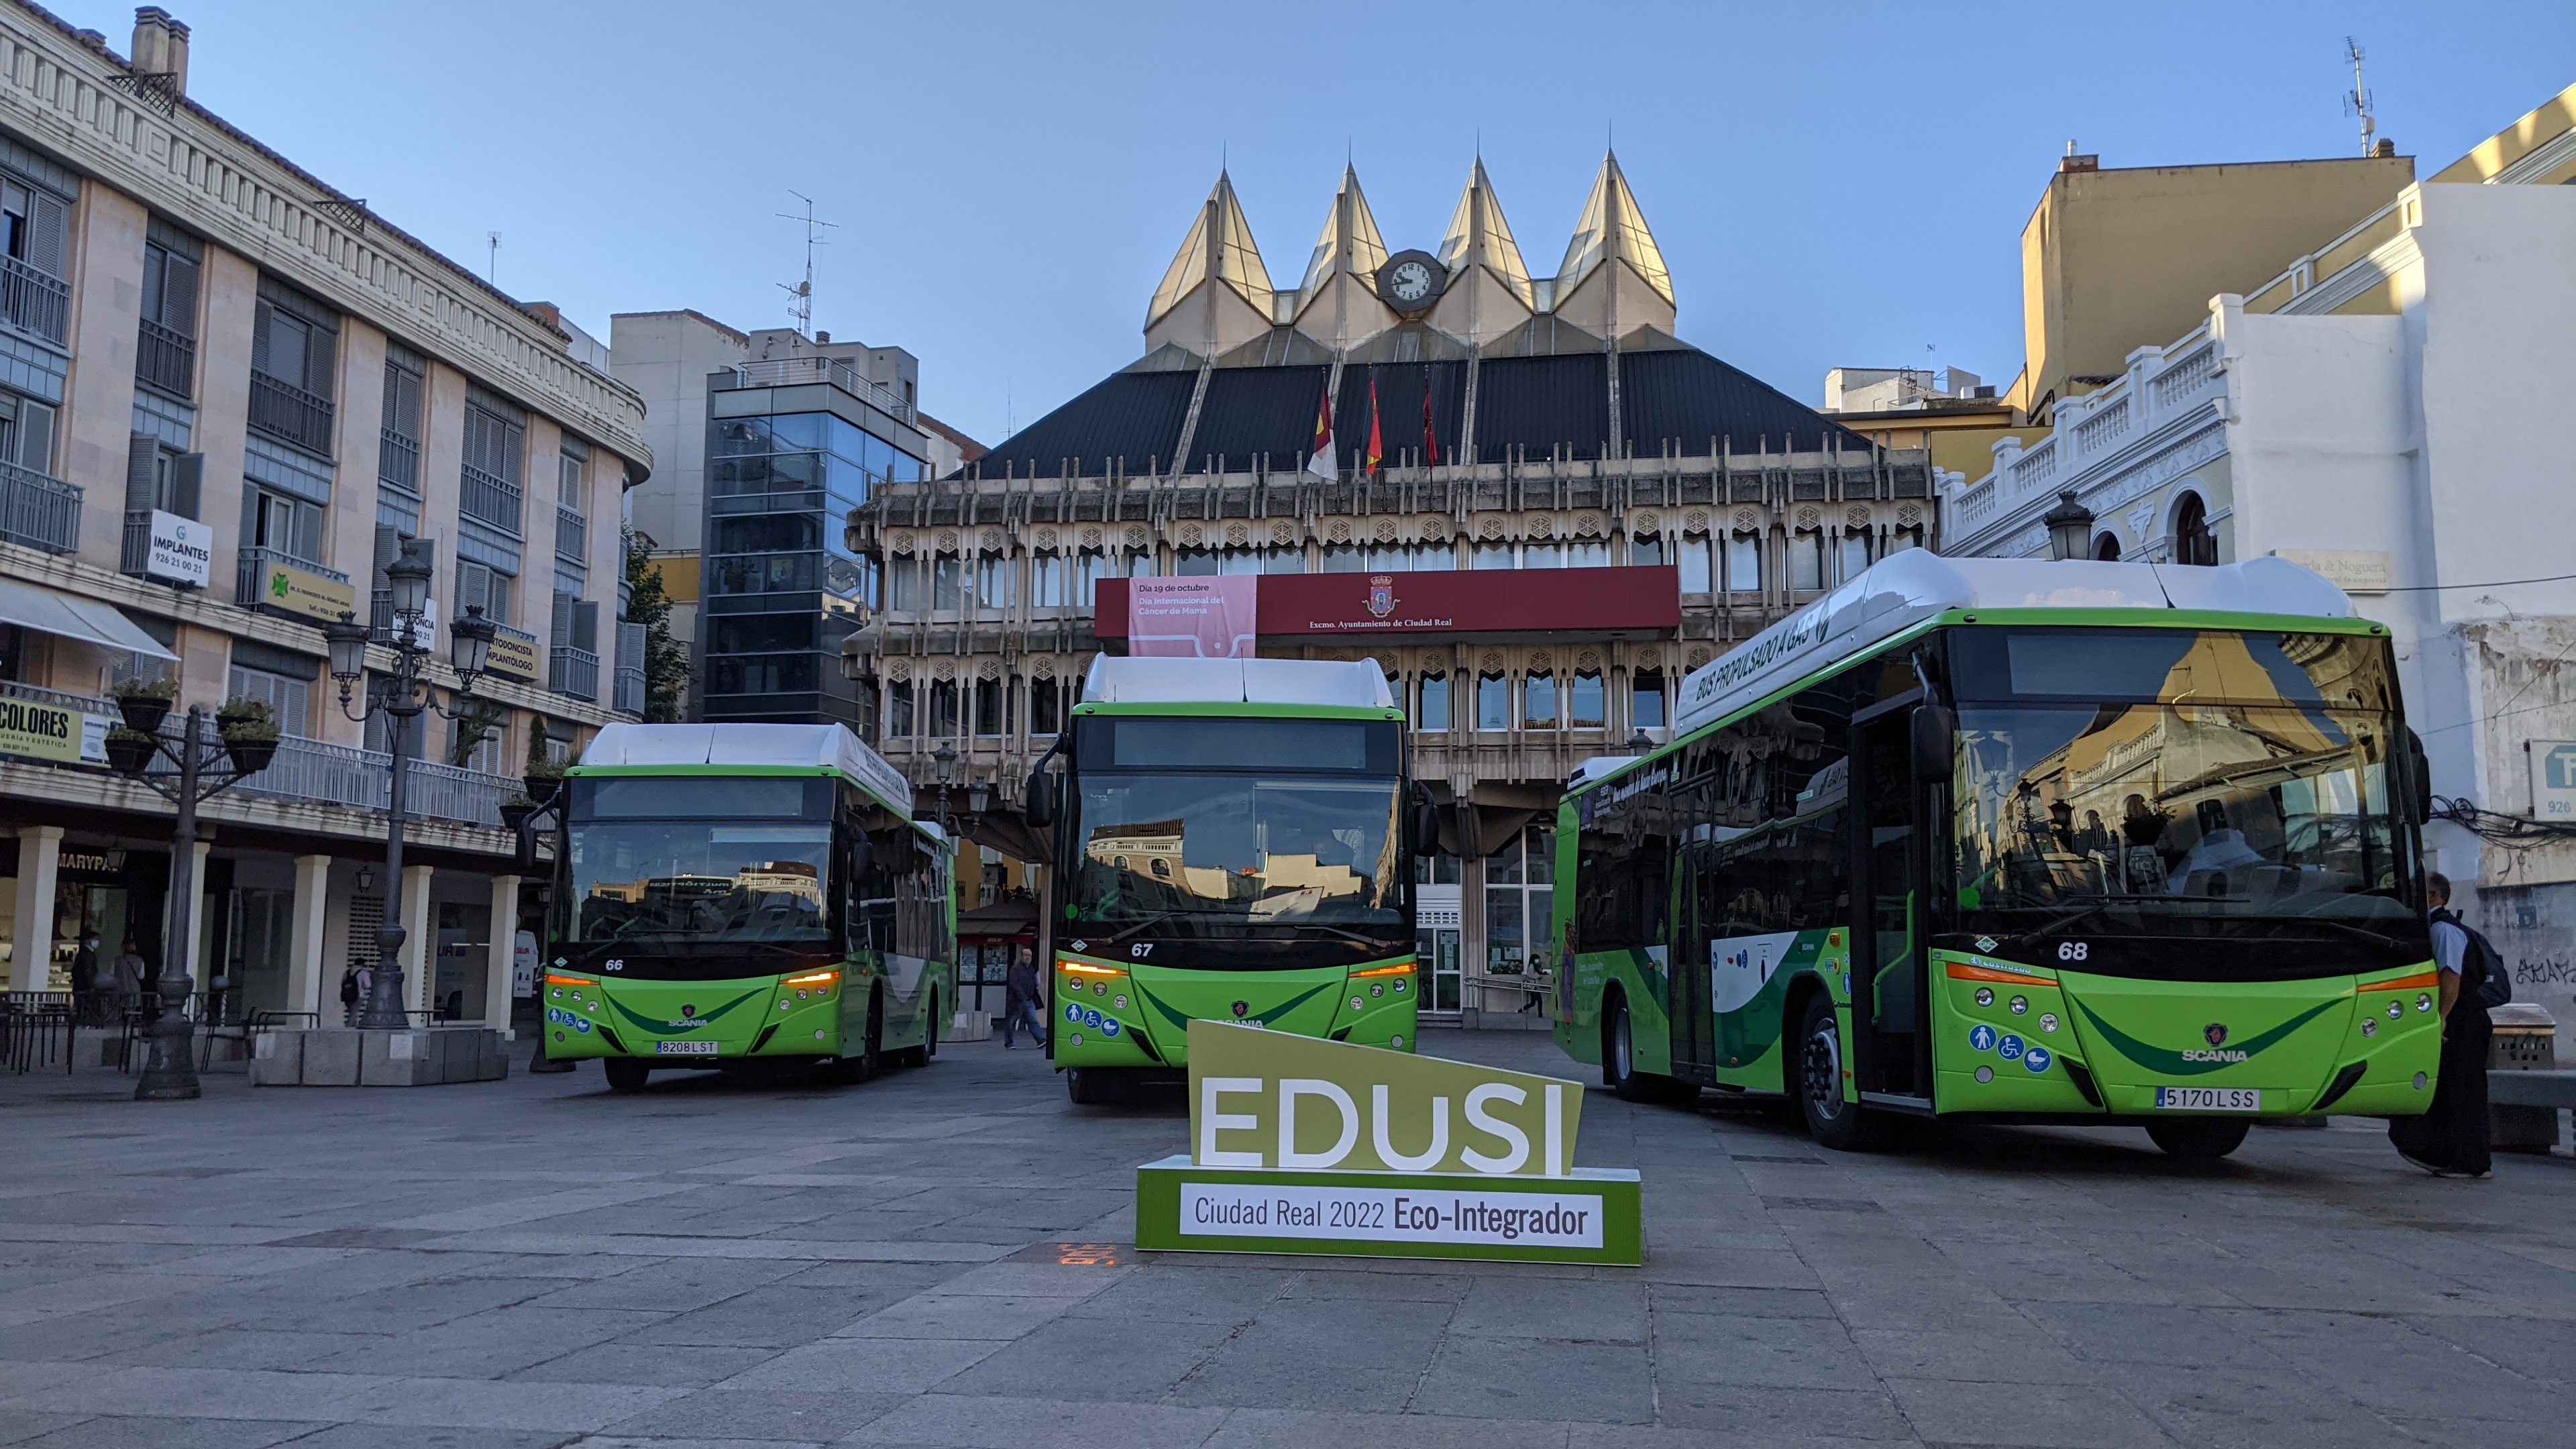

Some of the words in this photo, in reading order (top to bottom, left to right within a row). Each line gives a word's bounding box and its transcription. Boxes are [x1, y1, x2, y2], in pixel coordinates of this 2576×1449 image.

[154, 535, 209, 562] IMPLANTES
[156, 552, 169, 564] 926
[171, 557, 180, 568] 21
[182, 561, 192, 570] 00
[193, 564, 202, 574] 21
[2324, 563, 2334, 571] &
[1177, 584, 1210, 592] octubre
[1154, 596, 1209, 604] Internacional
[1338, 620, 1391, 629] Ayuntamiento
[1404, 619, 1433, 627] Ciudad
[1434, 618, 1452, 626] Real
[416, 630, 422, 638] 00
[424, 632, 430, 640] 21
[492, 637, 533, 657] RTODONCISTA
[487, 651, 533, 671] MPLANTÓLOGO
[1696, 672, 1716, 702] BUS
[1713, 634, 1779, 693] PROPULSADO
[1775, 629, 1788, 659] A
[1787, 613, 1813, 653] GAS
[0, 702, 68, 739] COLORES
[2548, 801, 2571, 813] 926
[58, 853, 118, 871] MARYPA
[1131, 943, 1154, 957] 67
[2057, 941, 2088, 961] 68
[606, 959, 623, 971] 66
[2182, 1050, 2248, 1062] SCANIA
[1199, 1077, 1562, 1175] EDUSI
[1195, 1197, 1267, 1225] Ciudad
[1277, 1199, 1322, 1227] Real
[1330, 1201, 1385, 1229] 2022
[1394, 1197, 1589, 1239] Eco-Integrador
